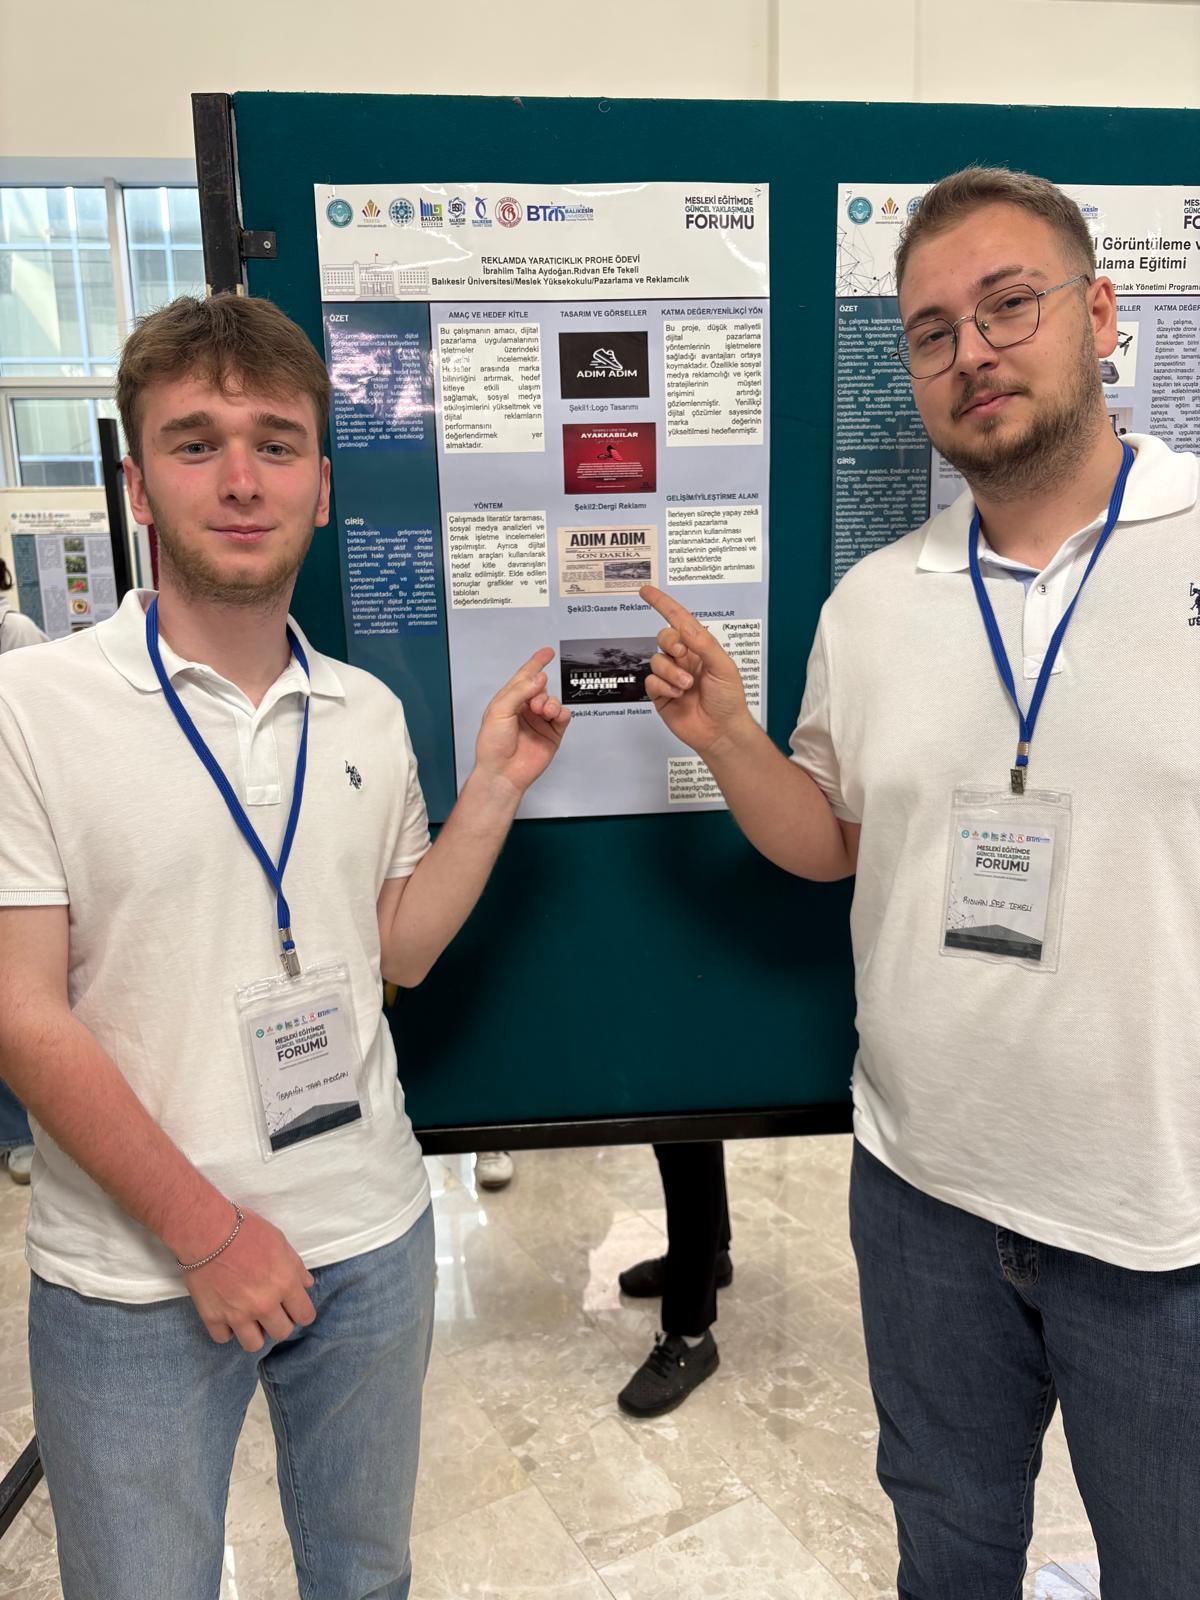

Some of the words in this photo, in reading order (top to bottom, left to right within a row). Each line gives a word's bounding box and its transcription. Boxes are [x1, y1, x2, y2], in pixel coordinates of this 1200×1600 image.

[685, 195, 716, 204] MESLEKİ
[718, 195, 753, 205] EĞİTİMDE
[712, 206, 753, 214] YAKLAŞIMLAR
[686, 214, 754, 229] FORUMU
[1184, 216, 1200, 229] FO
[1103, 237, 1191, 250] Görüntüleme
[615, 254, 640, 263] ÖDEVİ
[1095, 257, 1134, 269] ulama
[1140, 257, 1186, 272] Eğitimi
[646, 275, 690, 283] Reklamcılık
[330, 314, 349, 322] ÖZET
[508, 310, 528, 318] KİTLE
[521, 327, 538, 335] dijital
[837, 457, 855, 465] GİRİŞ
[571, 534, 605, 546] ADIM
[611, 532, 645, 545] ADIM
[1188, 617, 1200, 626] US
[1002, 846, 1030, 854] EĞİTİMDE
[976, 857, 1029, 872] FORUMU
[275, 1033, 298, 1045] MESLEKİ
[299, 1024, 324, 1037] EĞİTİMDE
[278, 1036, 327, 1061] FORUMU
